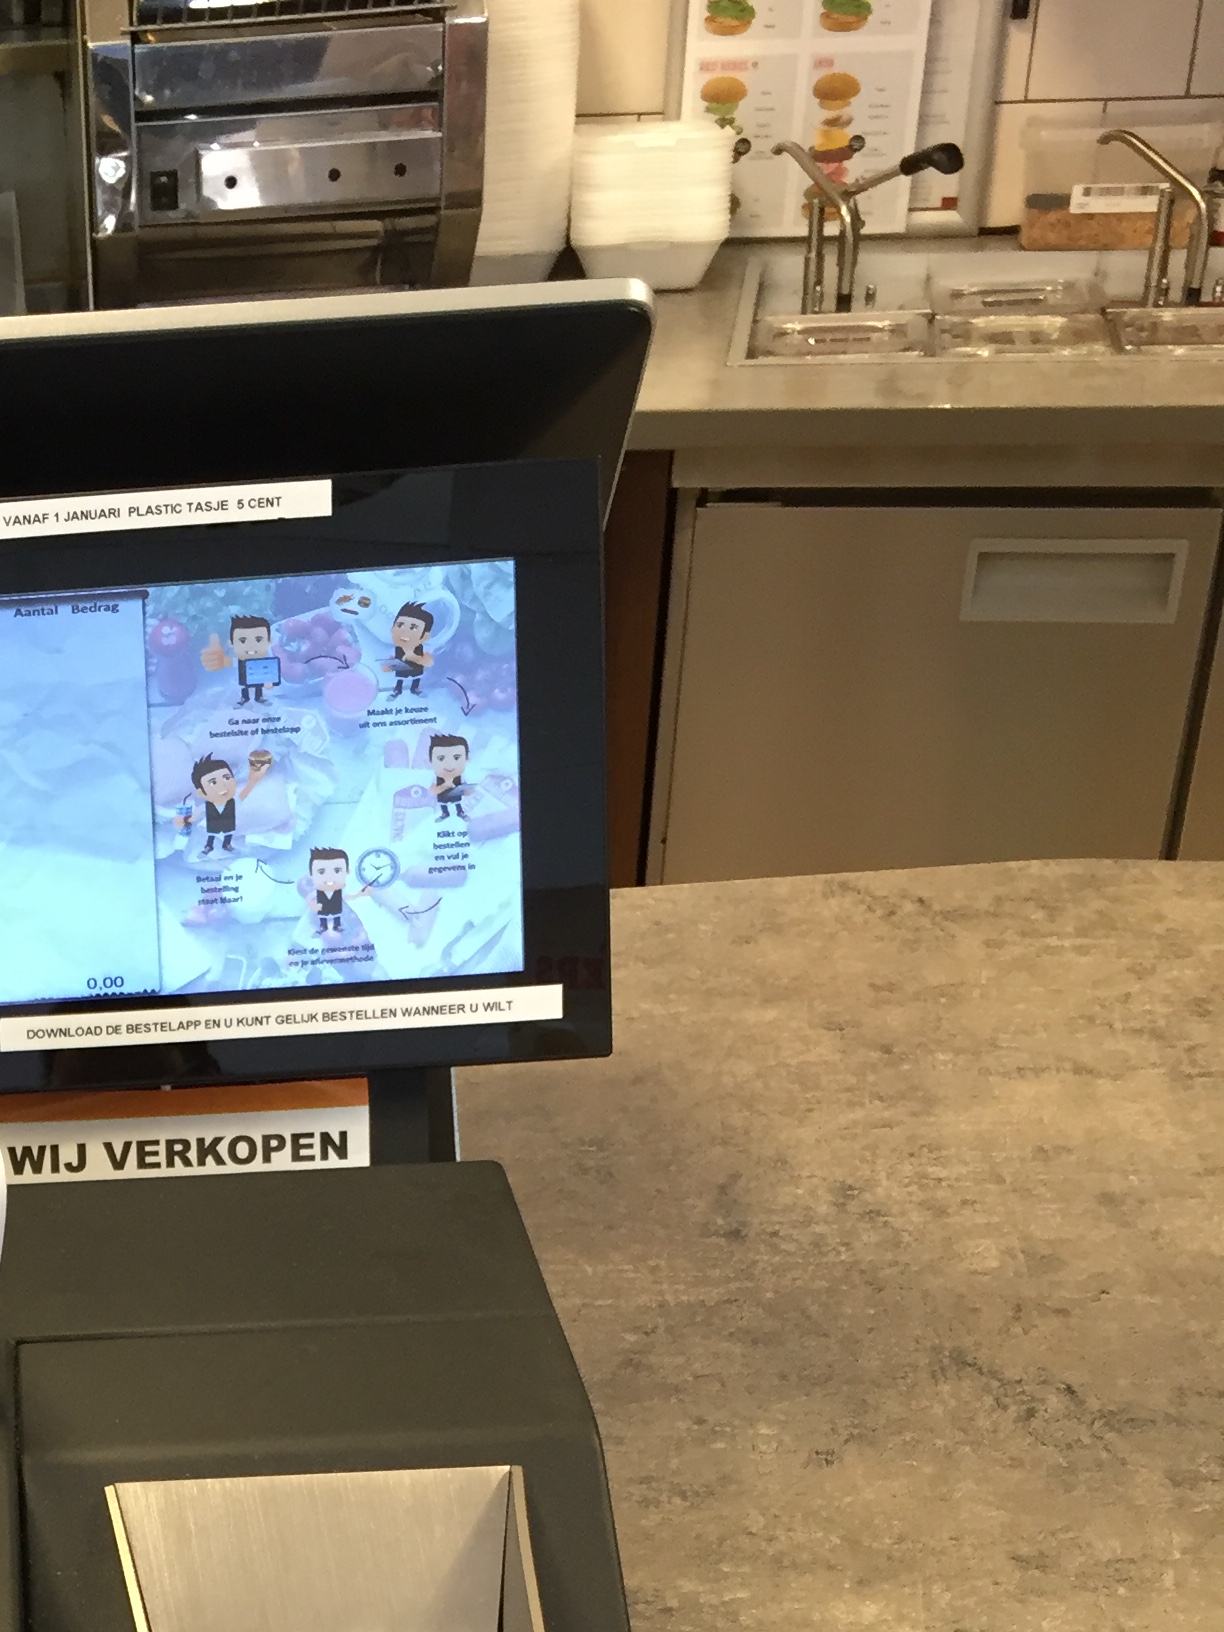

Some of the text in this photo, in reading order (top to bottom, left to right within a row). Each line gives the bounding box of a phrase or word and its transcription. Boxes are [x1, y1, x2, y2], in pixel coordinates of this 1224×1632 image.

[3, 496, 282, 528] VANAF 1 JANUARI PLASTIC TASJE 5 CENT
[14, 605, 59, 618] Aantal
[71, 602, 120, 615] Bedrag
[367, 706, 429, 717] Maakt je keuze
[228, 718, 239, 726] Ga
[241, 717, 260, 725] naar
[372, 720, 387, 728] ons
[388, 716, 438, 727] assortiment
[250, 728, 259, 736] of
[433, 841, 470, 850] bestellen
[447, 852, 459, 861] vul
[86, 976, 125, 991] 0,00
[26, 1000, 514, 1041] DOWNLOAD DE BESTELAPP EN U KUNT GELIJK BESTELLEN WANNEER U WILT
[6, 1130, 349, 1176] WIJ VERKOPEN
